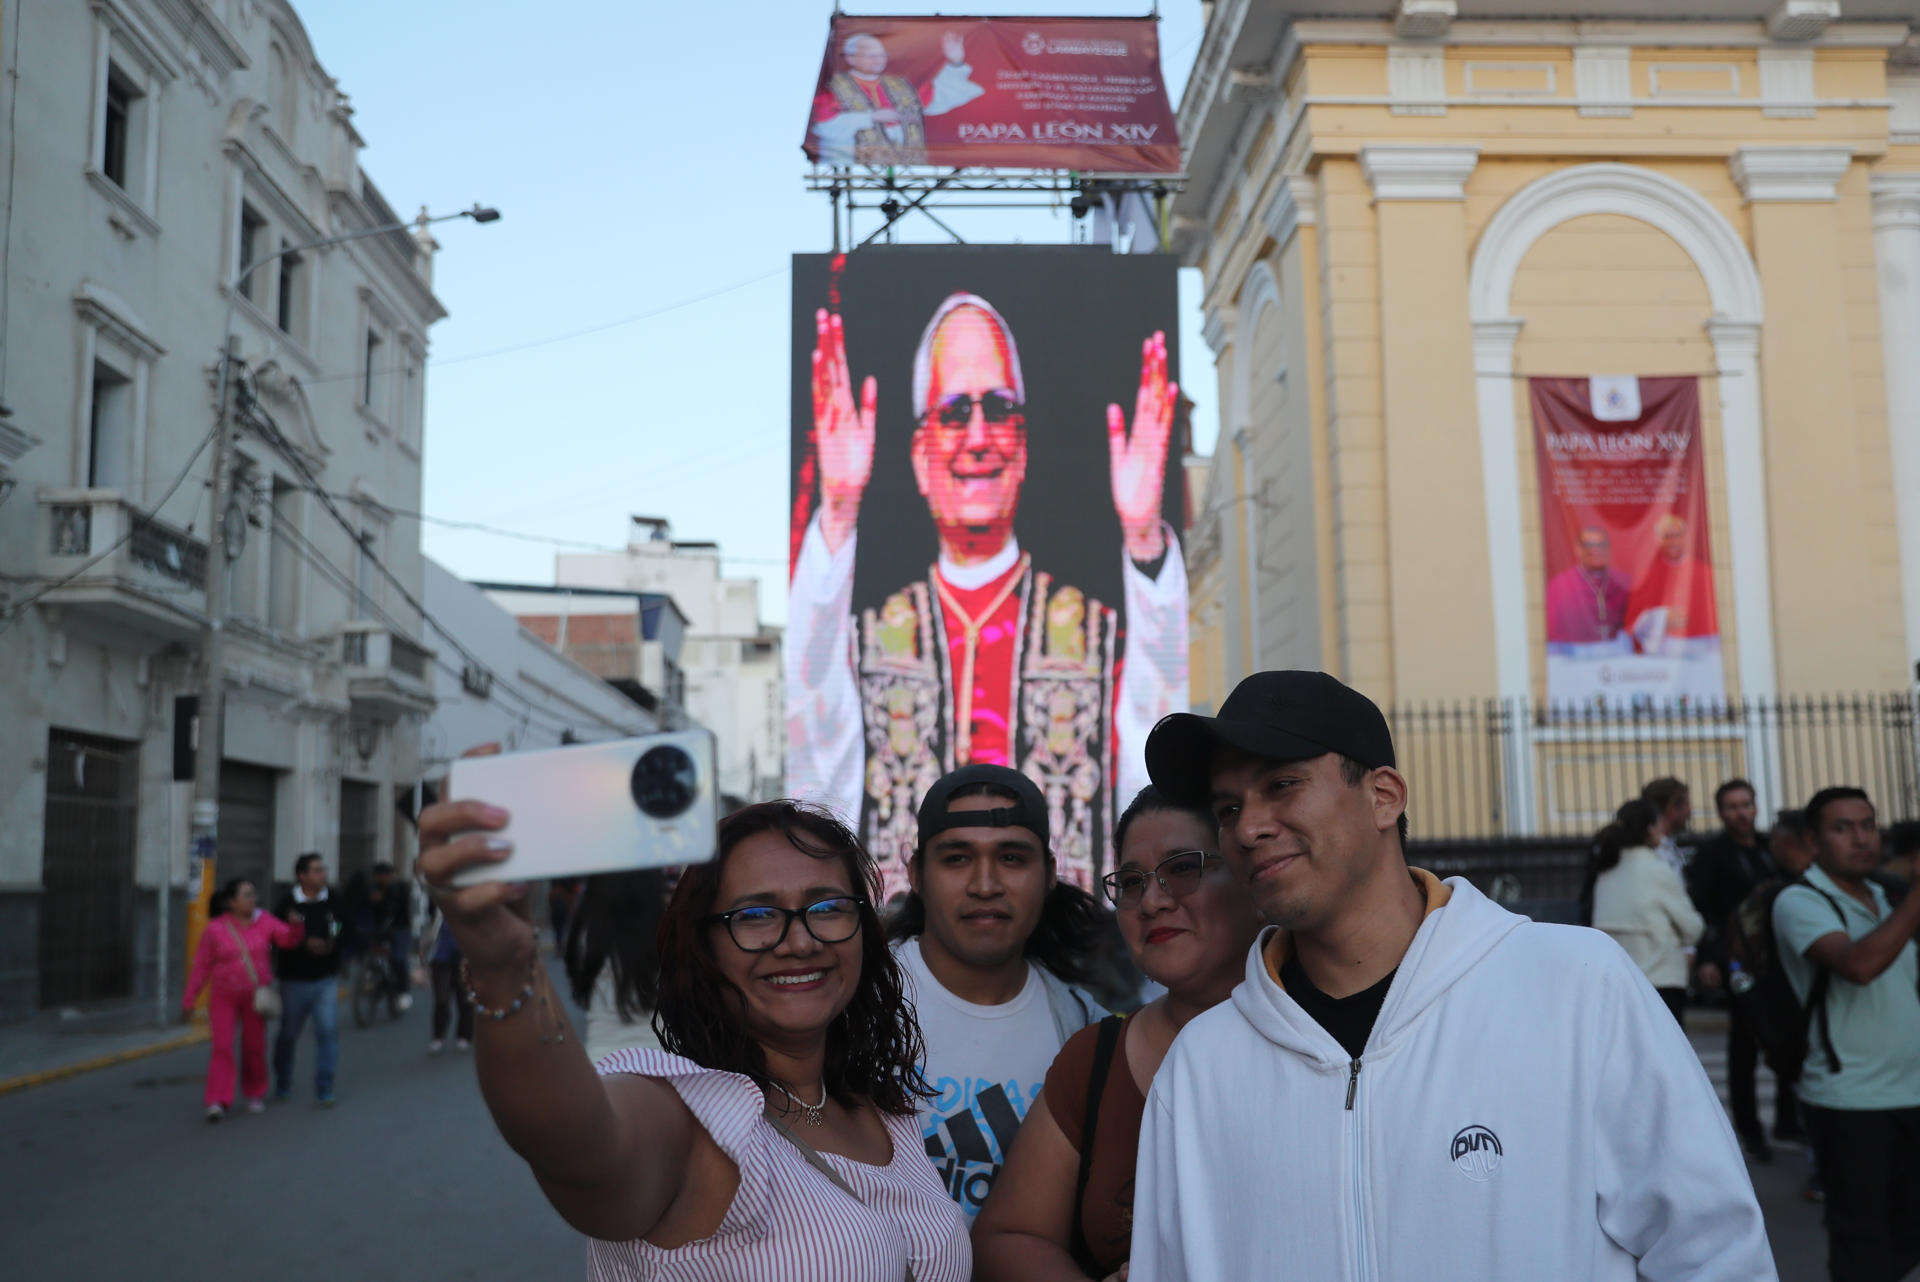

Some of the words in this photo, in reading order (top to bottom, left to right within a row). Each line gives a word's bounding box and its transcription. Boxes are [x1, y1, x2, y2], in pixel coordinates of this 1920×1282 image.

[958, 123, 1025, 139] PAPA
[1032, 120, 1103, 139] LEÓN
[1110, 123, 1159, 139] XIV
